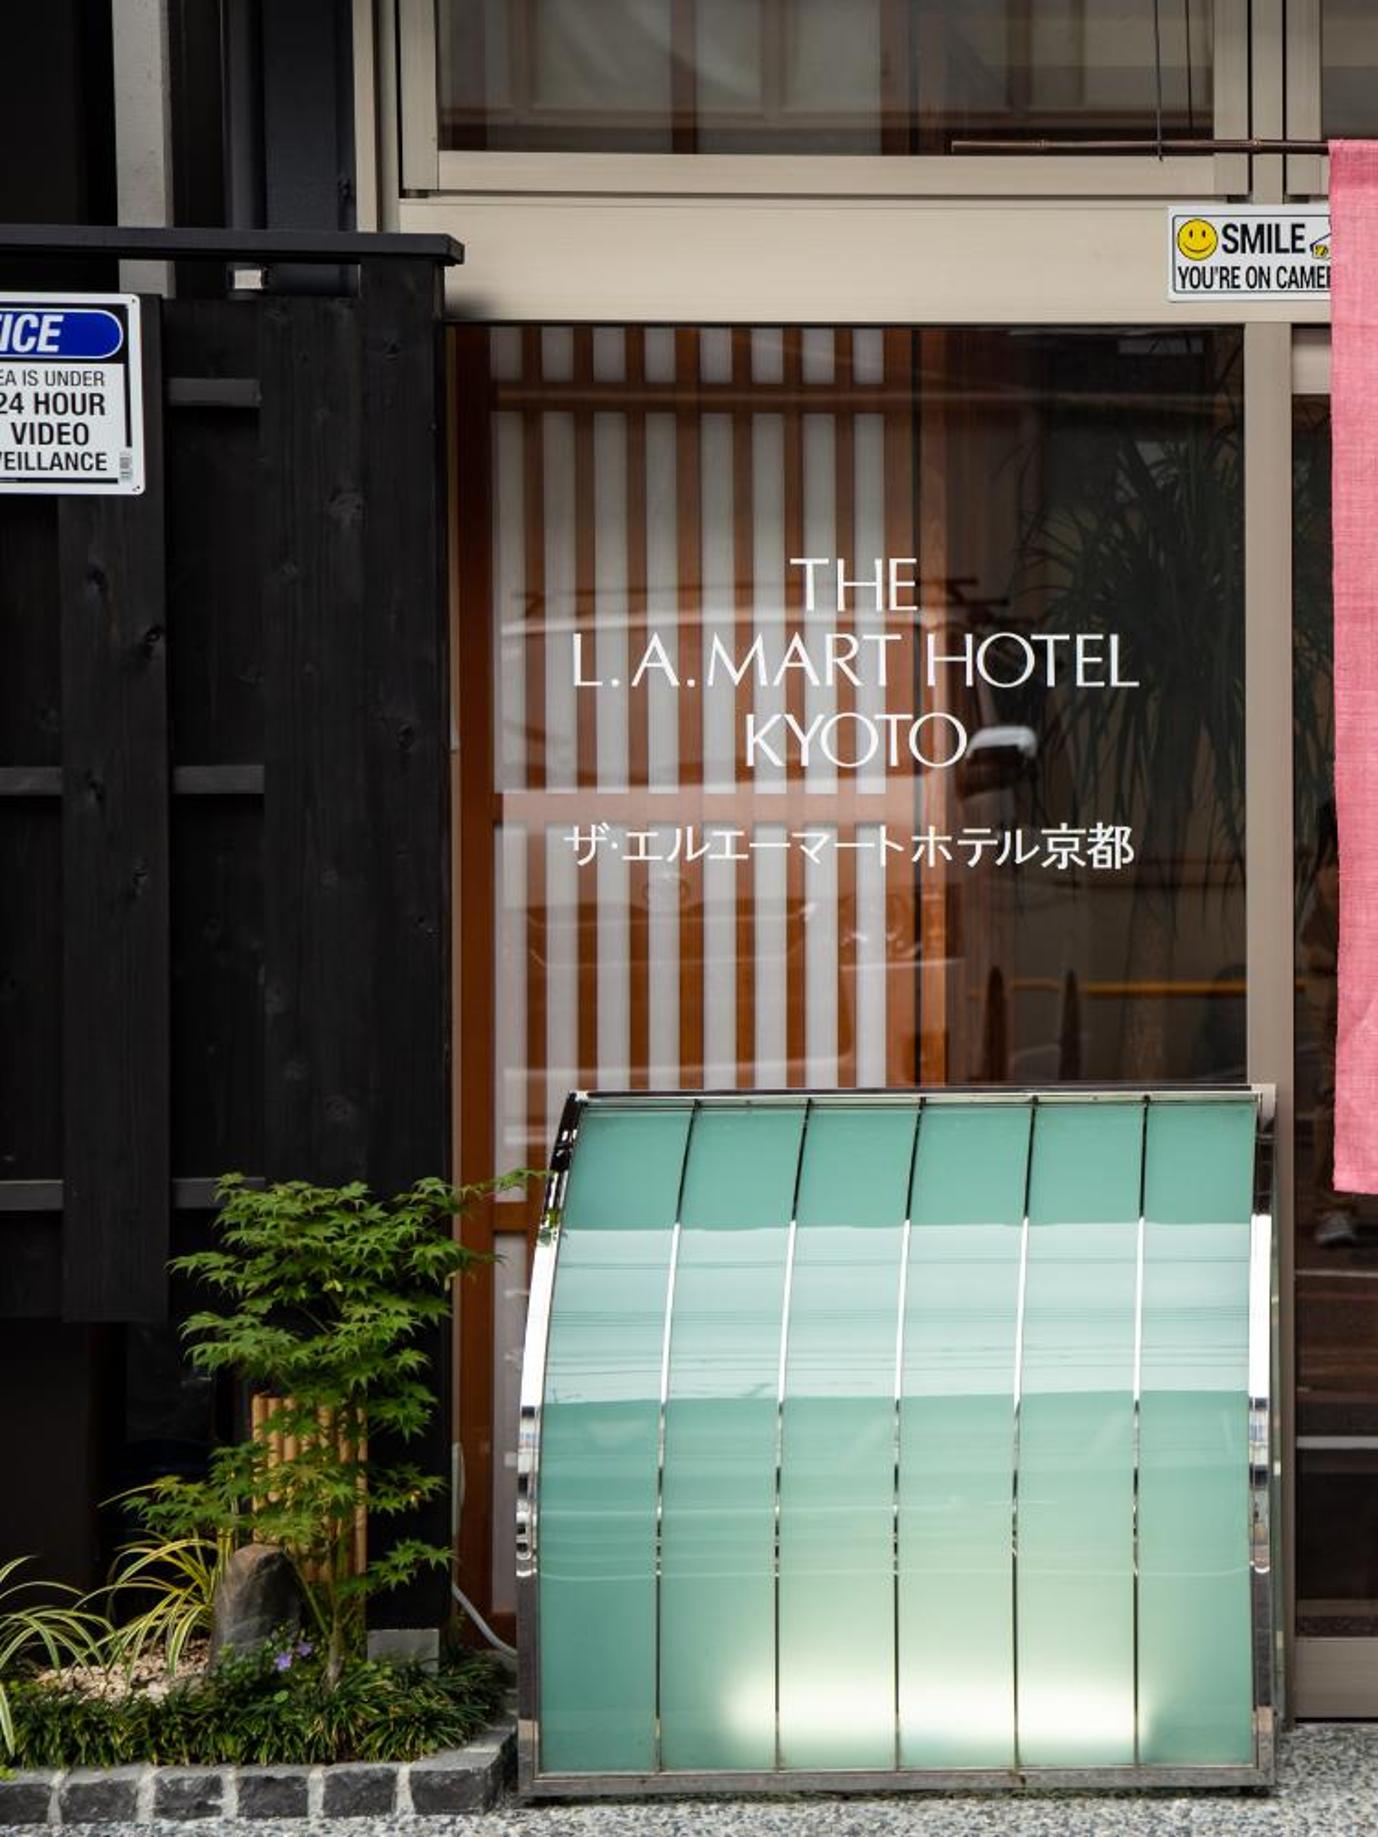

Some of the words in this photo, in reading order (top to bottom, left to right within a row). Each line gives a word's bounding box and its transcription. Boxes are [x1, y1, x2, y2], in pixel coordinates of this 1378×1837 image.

[1221, 223, 1305, 254] SMILE
[1177, 265, 1241, 289] YOU'RE
[1245, 265, 1271, 289] ON
[1275, 265, 1331, 289] CAME
[0, 313, 64, 353] ICE
[23, 369, 38, 386] IS
[45, 370, 105, 386] UNDER
[34, 392, 106, 416] HOUR
[11, 422, 90, 445] VIDEO
[790, 558, 918, 612] THE
[572, 631, 901, 688] L.A.MART
[927, 632, 1139, 688] HOTEL
[746, 712, 968, 768] KYOTO
[564, 822, 1135, 871] ザ・エルエーマートホテル京都
